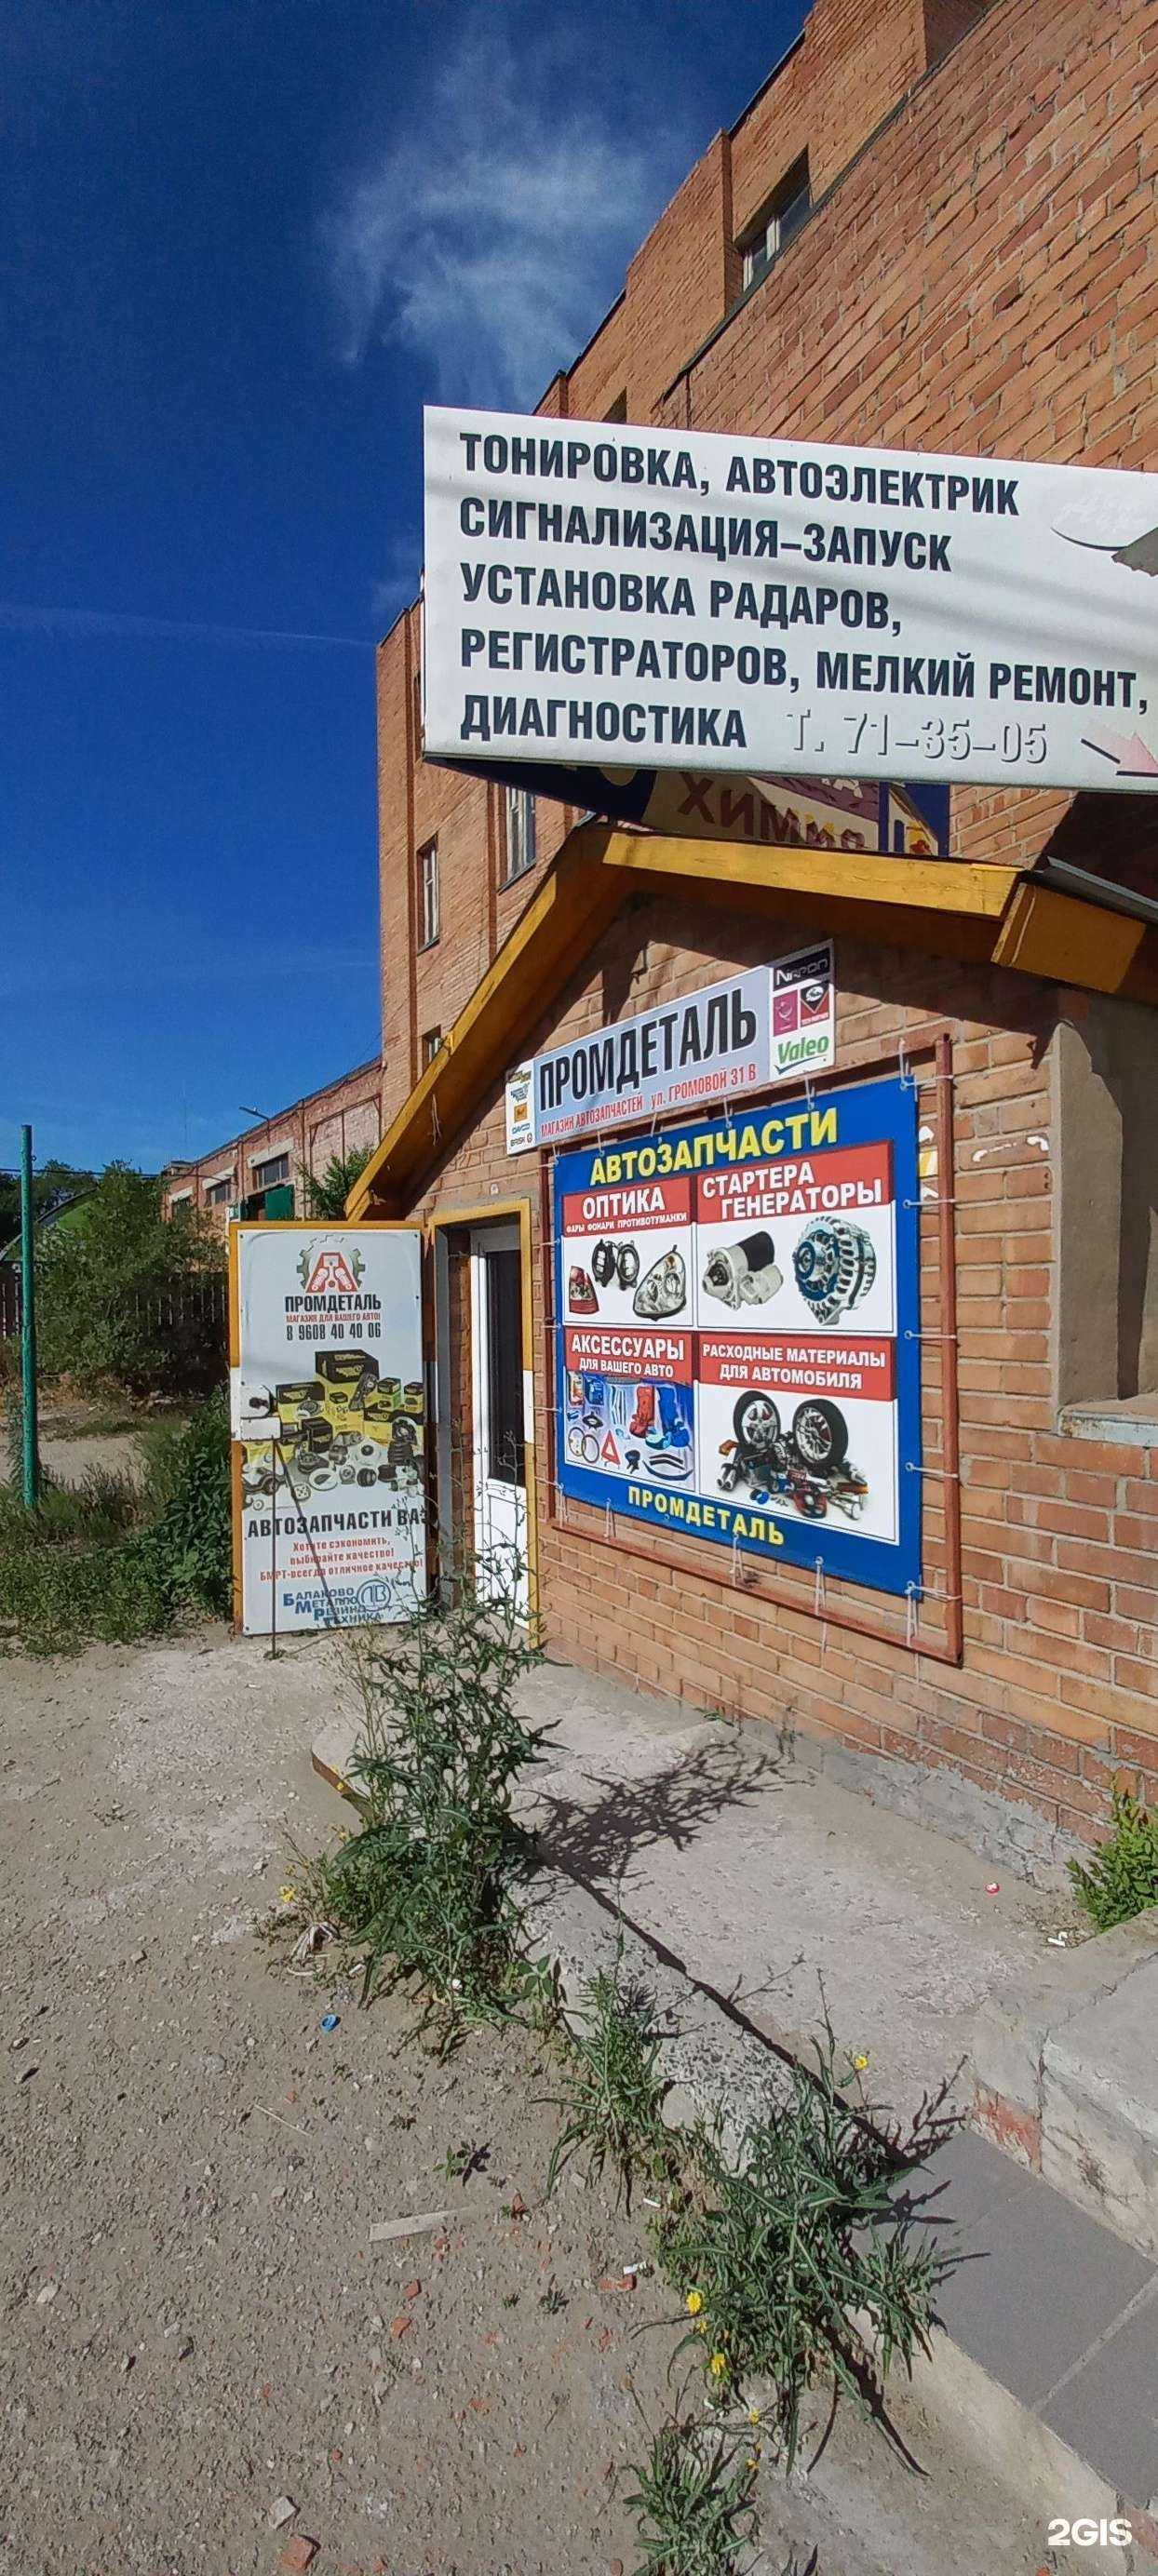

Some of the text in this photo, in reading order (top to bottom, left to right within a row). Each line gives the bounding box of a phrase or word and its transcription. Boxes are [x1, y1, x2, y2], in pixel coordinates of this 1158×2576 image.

[459, 433, 1020, 517] ТОНИРОВКА, АВТОЭЛЕКТРИК
[459, 562, 902, 637] УСТАНОВКА РАДАРОВ,
[460, 627, 1149, 716] РЕГИСТРАТОРОВ, МЕЛКИЙ РЕМОНТ,
[459, 694, 1049, 764] ДИАГНОСТИКА Т. 71-35-05
[539, 987, 758, 1112] ПРОМДЕТАЛЬ
[778, 1035, 829, 1065] Valeo
[541, 1119, 575, 1137] МАГАЗИН
[575, 1093, 644, 1130] АВТОЗАПЧАСТЕЙ
[668, 1067, 728, 1103] ГРОМОВОЙ
[730, 1067, 745, 1087] 31
[588, 1107, 838, 1187] АВТОЗАПЧАСТИ
[702, 1161, 815, 1200] СТАРТЕРА
[582, 1186, 667, 1221] ОПТИКА
[720, 1177, 882, 1220] ГЕНЕРАТОРЫ
[566, 1212, 688, 1234] ФАРЫ ФОНАРИ ПРОТИВОТУМАНКИ
[284, 1294, 383, 1313] ПРОМДЕТАЛЬ
[286, 1314, 317, 1323] МАГАЗИН
[318, 1313, 333, 1322] ДЛЯ
[286, 1322, 382, 1341] 8 9608 40 40 06
[571, 1333, 685, 1361] АКСЕССУАРЫ
[578, 1357, 675, 1378] ДЛЯ ВАШЕГО АВТО
[702, 1342, 886, 1368] РАСХОДНЫЕ МАТЕРИАЛЫ
[719, 1363, 863, 1390] ДЛЯ АВТОМОБИЛЯ
[248, 1509, 393, 1538] АВТОЗАПЧАСТИ
[627, 1485, 785, 1546] ПРОМДЕТАЛЬ
